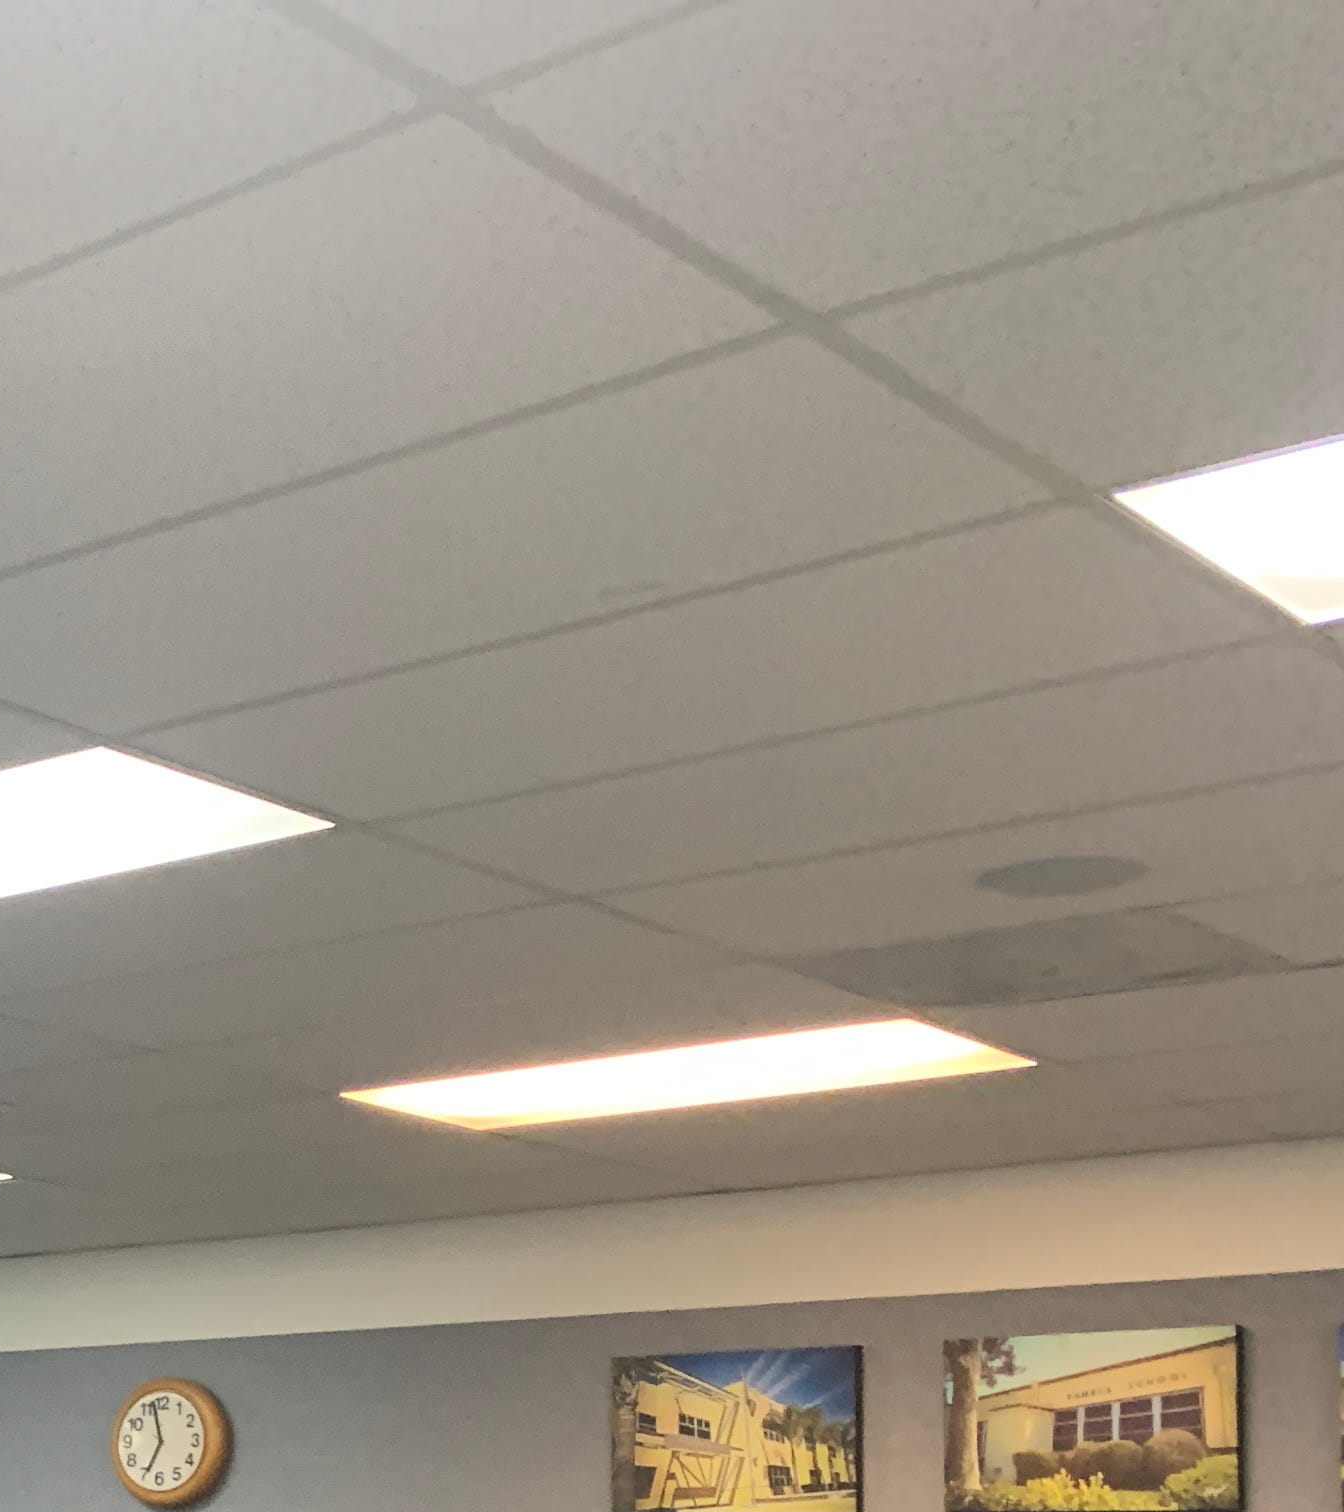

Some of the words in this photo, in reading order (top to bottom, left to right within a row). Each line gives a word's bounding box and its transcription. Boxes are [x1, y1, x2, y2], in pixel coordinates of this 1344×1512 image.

[155, 1395, 170, 1411] 12
[176, 1401, 183, 1416] 1
[128, 1417, 144, 1432] 10
[186, 1413, 195, 1428] 2
[123, 1434, 133, 1449] 9
[191, 1433, 200, 1448] 3
[126, 1453, 137, 1468] 8
[184, 1453, 195, 1467] 4
[154, 1471, 165, 1486] 6
[171, 1467, 182, 1482] 5
